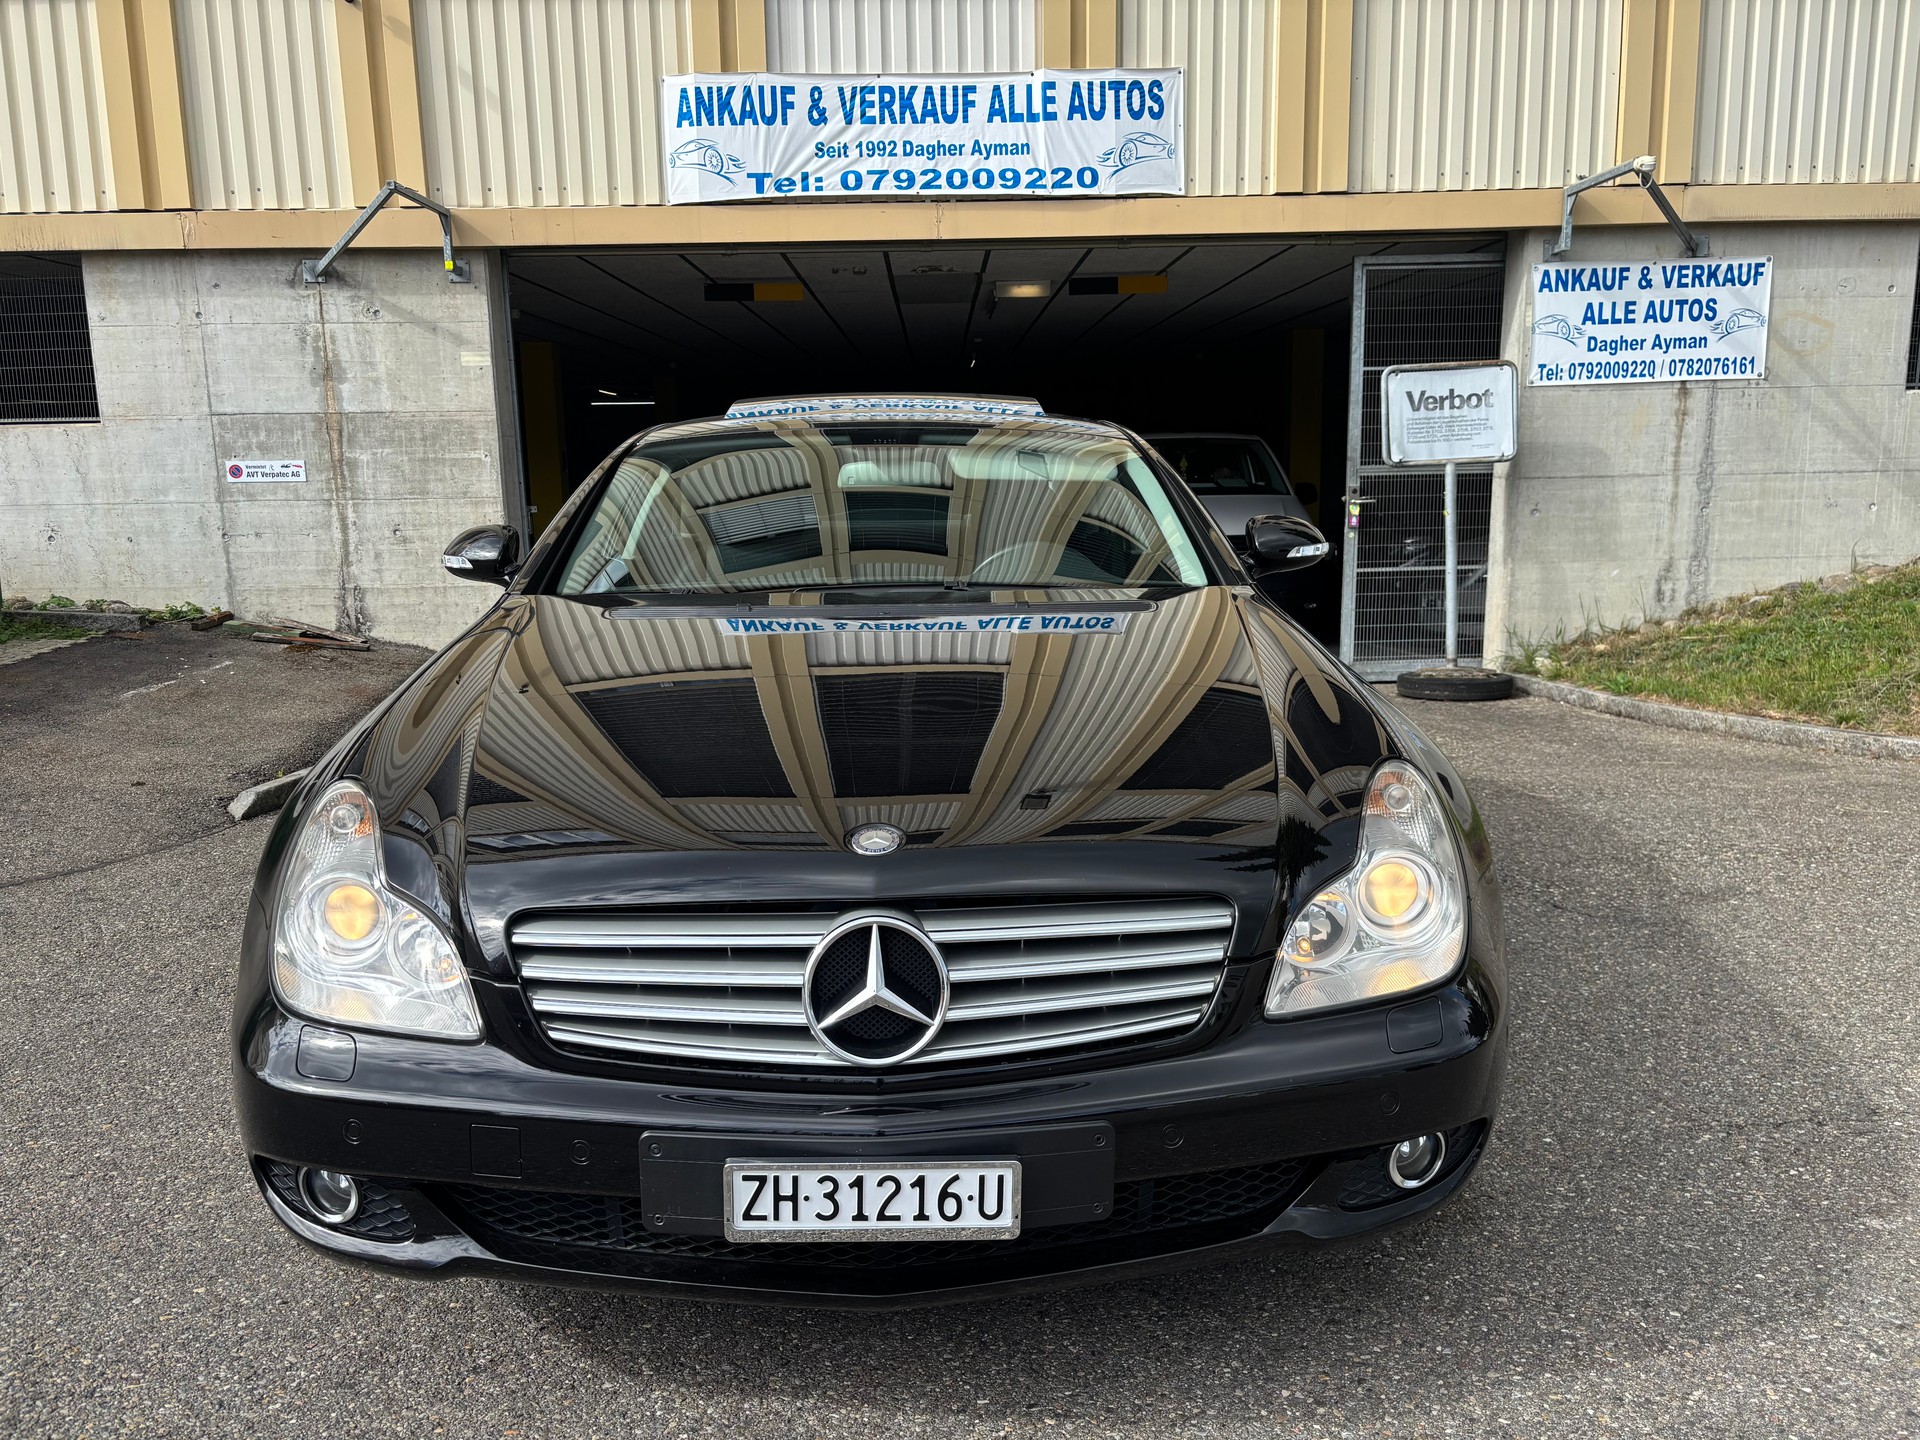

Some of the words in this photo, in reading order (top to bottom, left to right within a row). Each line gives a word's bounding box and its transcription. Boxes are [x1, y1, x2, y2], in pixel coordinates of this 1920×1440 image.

[676, 84, 796, 128] ANKAUF
[807, 85, 829, 127] &
[838, 83, 977, 126] VERKAUF
[987, 81, 1057, 123] ALLE
[1066, 79, 1165, 121] AUTOS
[814, 140, 849, 160] Seit
[855, 139, 898, 159] 1992
[902, 139, 966, 163] Dagher
[970, 139, 1031, 162] Ayman
[746, 171, 824, 194] Tel:
[840, 166, 1099, 193] 0792009220
[1538, 266, 1631, 293] ANKAUF
[1637, 265, 1653, 290] &
[1661, 262, 1766, 289] VERKAUF
[1581, 300, 1637, 326] ALLE
[1643, 298, 1718, 324] AUTOS
[1587, 335, 1647, 356] Dagher
[1650, 333, 1708, 354] Ayman
[1537, 363, 1564, 381] Tel:
[1568, 359, 1656, 381] 0792009220
[1659, 359, 1665, 377] /
[1668, 356, 1756, 377] 0782076161
[1405, 388, 1493, 413] Verbot
[260, 471, 290, 479] Verpatec
[290, 470, 301, 478] AG
